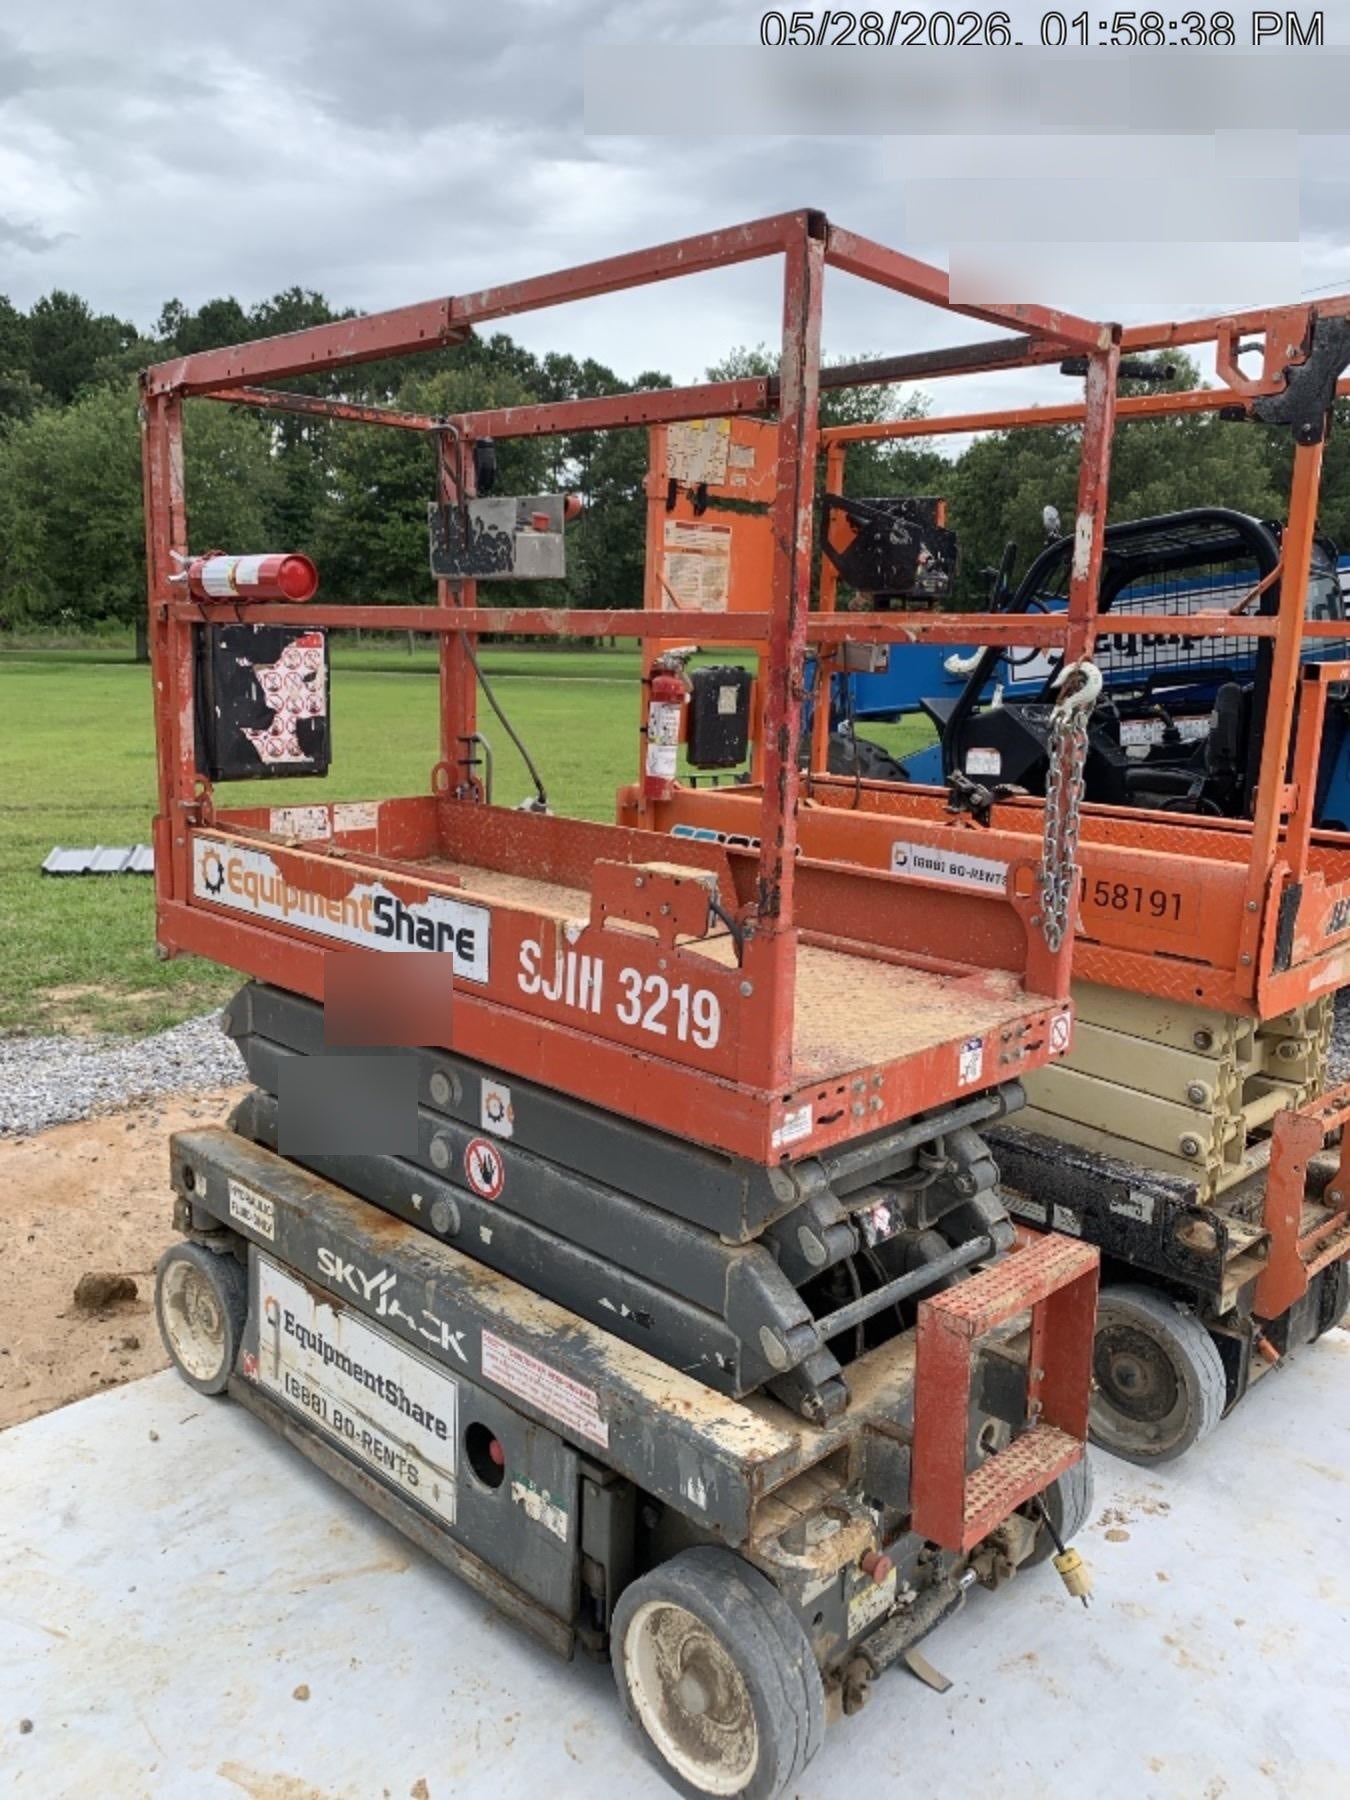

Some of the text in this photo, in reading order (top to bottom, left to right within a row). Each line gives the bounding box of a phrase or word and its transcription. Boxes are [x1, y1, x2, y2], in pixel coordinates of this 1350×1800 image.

[227, 858, 474, 962] EquipmentShare
[616, 967, 720, 1049] 3219
[284, 1310, 447, 1440] EquipmentShare
